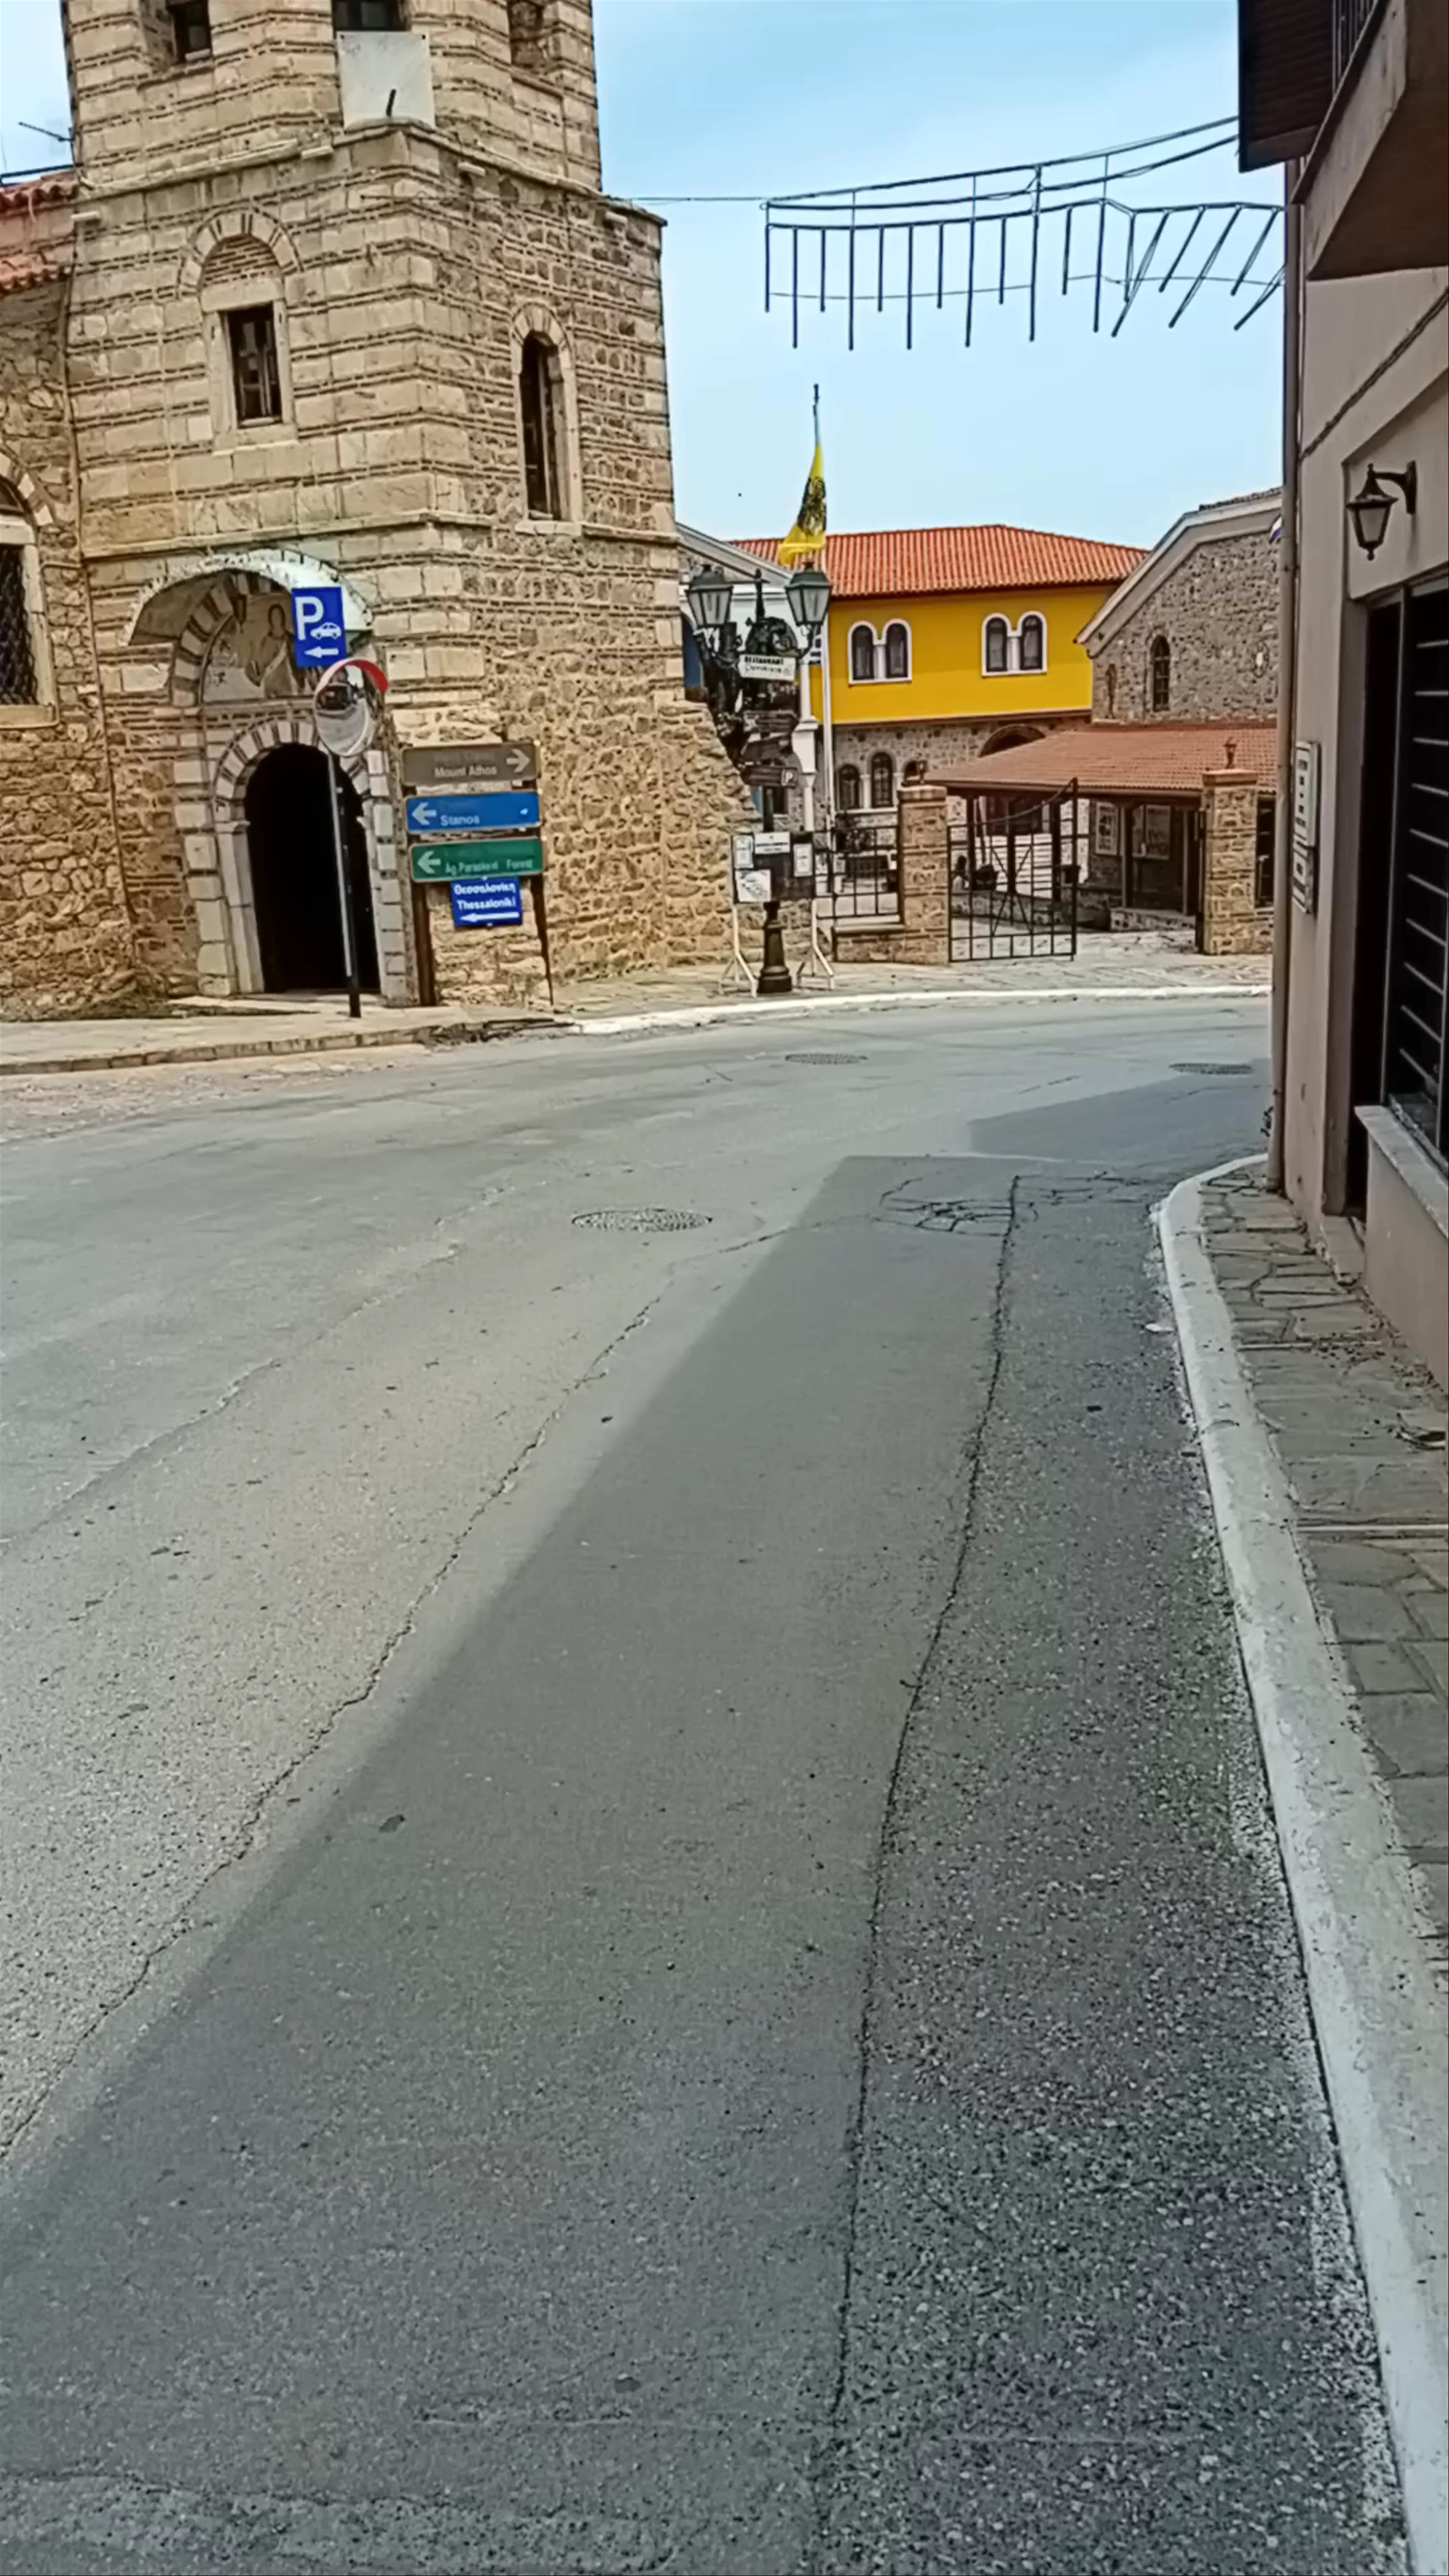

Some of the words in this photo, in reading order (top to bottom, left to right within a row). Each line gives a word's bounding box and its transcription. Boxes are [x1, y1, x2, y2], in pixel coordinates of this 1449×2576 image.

[294, 595, 324, 641] P
[435, 767, 466, 778] Mount
[468, 764, 497, 776] Athos
[440, 815, 480, 826] Stanos
[457, 896, 517, 910] Thessaloniki
